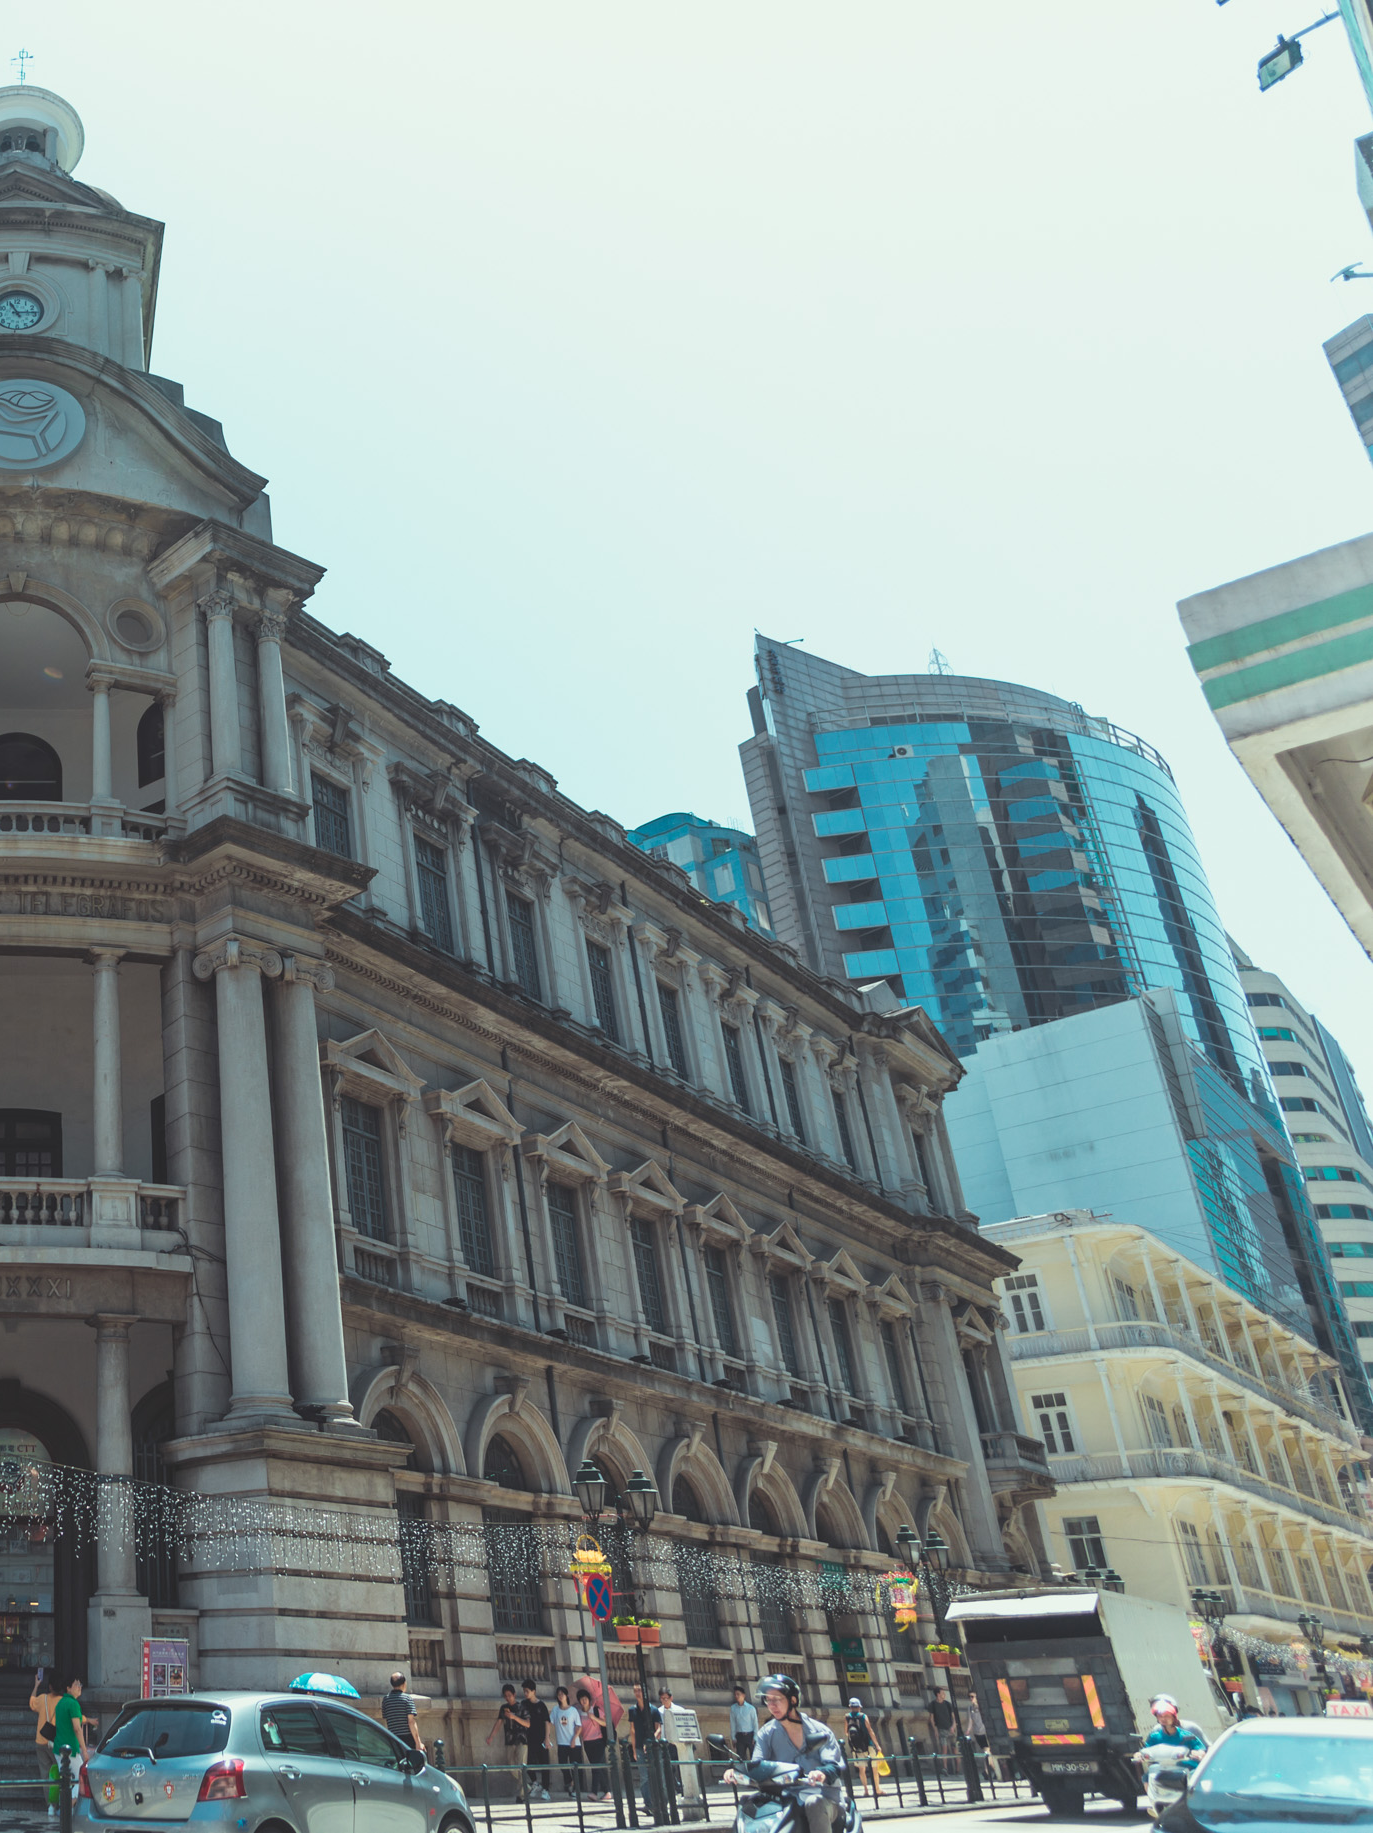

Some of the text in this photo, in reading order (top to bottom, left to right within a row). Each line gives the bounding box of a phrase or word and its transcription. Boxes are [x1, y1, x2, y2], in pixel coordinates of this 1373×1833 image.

[16, 890, 166, 922] TELEGRAFOS
[17, 1445, 36, 1453] CTT
[1330, 1704, 1369, 1717] TAXI
[1051, 1763, 1090, 1772] MM-30-52
